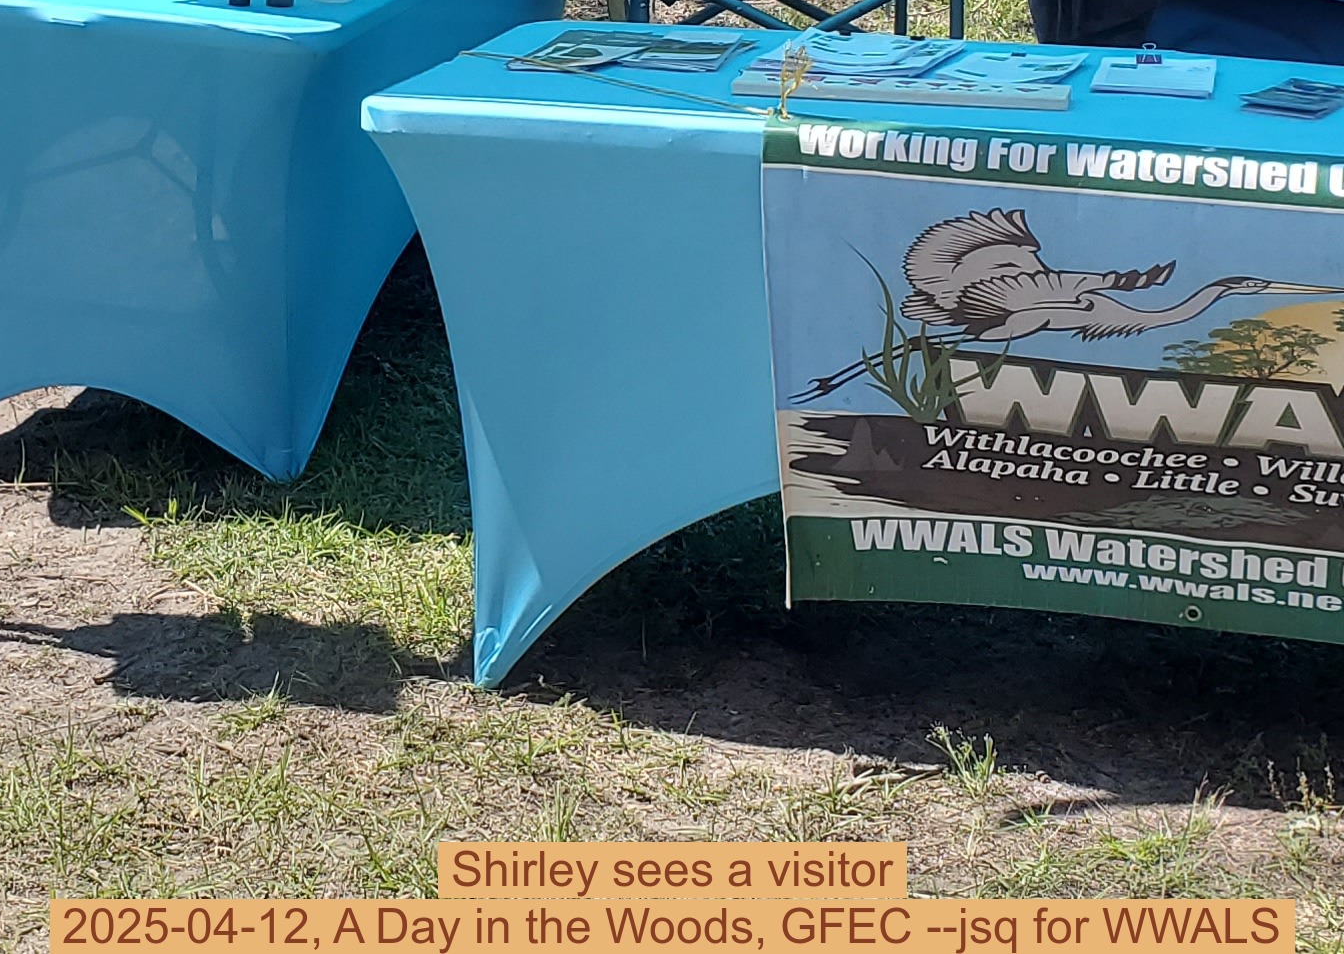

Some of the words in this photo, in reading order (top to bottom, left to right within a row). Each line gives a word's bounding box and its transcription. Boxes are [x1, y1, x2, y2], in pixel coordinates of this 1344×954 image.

[797, 123, 978, 173] Working
[987, 137, 1057, 174] For
[1066, 142, 1318, 195] Watershed
[922, 449, 1089, 487] Alapaha
[1132, 470, 1240, 497] Little
[923, 426, 1209, 468] Withlacoochee
[850, 518, 1034, 559] WWALS
[1045, 528, 1328, 590] Watershed
